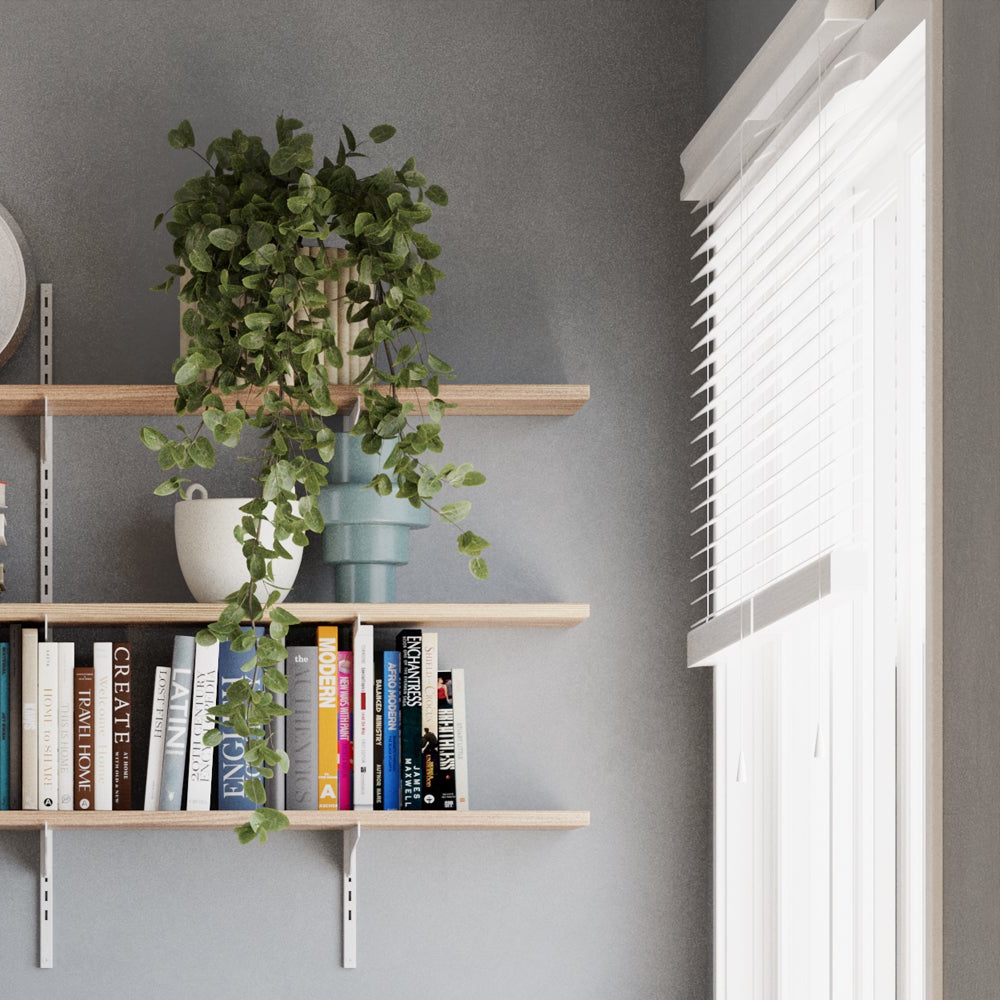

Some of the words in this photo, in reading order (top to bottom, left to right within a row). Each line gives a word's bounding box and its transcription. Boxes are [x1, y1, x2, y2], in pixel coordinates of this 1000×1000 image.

[294, 655, 309, 663] the
[318, 637, 337, 708] MODERN
[387, 661, 397, 692] AFRO
[406, 635, 421, 707] ENCHANTRESS
[425, 646, 435, 676] SHIELD
[113, 646, 130, 744] CREATE
[156, 670, 167, 702] LOST
[339, 676, 350, 692] NEW
[339, 691, 350, 708] WAYS
[375, 678, 383, 713] BALANCED
[43, 687, 53, 723] HOME
[60, 703, 70, 728] THIS
[78, 688, 91, 741] TRAVEL
[98, 673, 109, 737] Welcome
[193, 671, 206, 737] CENTURY
[339, 707, 350, 724] WITH
[387, 693, 397, 731] MODERN
[44, 730, 52, 742] to
[60, 730, 70, 739] IS
[153, 708, 164, 739] FISH
[294, 667, 312, 804] AUTHENTICS
[339, 724, 350, 741] PAINT
[43, 745, 53, 787] SHARE
[60, 741, 70, 774] HOME
[78, 745, 91, 792] HOME
[98, 744, 109, 784] Home
[123, 751, 129, 760] AT
[190, 741, 202, 782] 20TH
[319, 783, 337, 799] A
[404, 757, 413, 808] MAXWELL
[412, 765, 421, 800] JAMES
